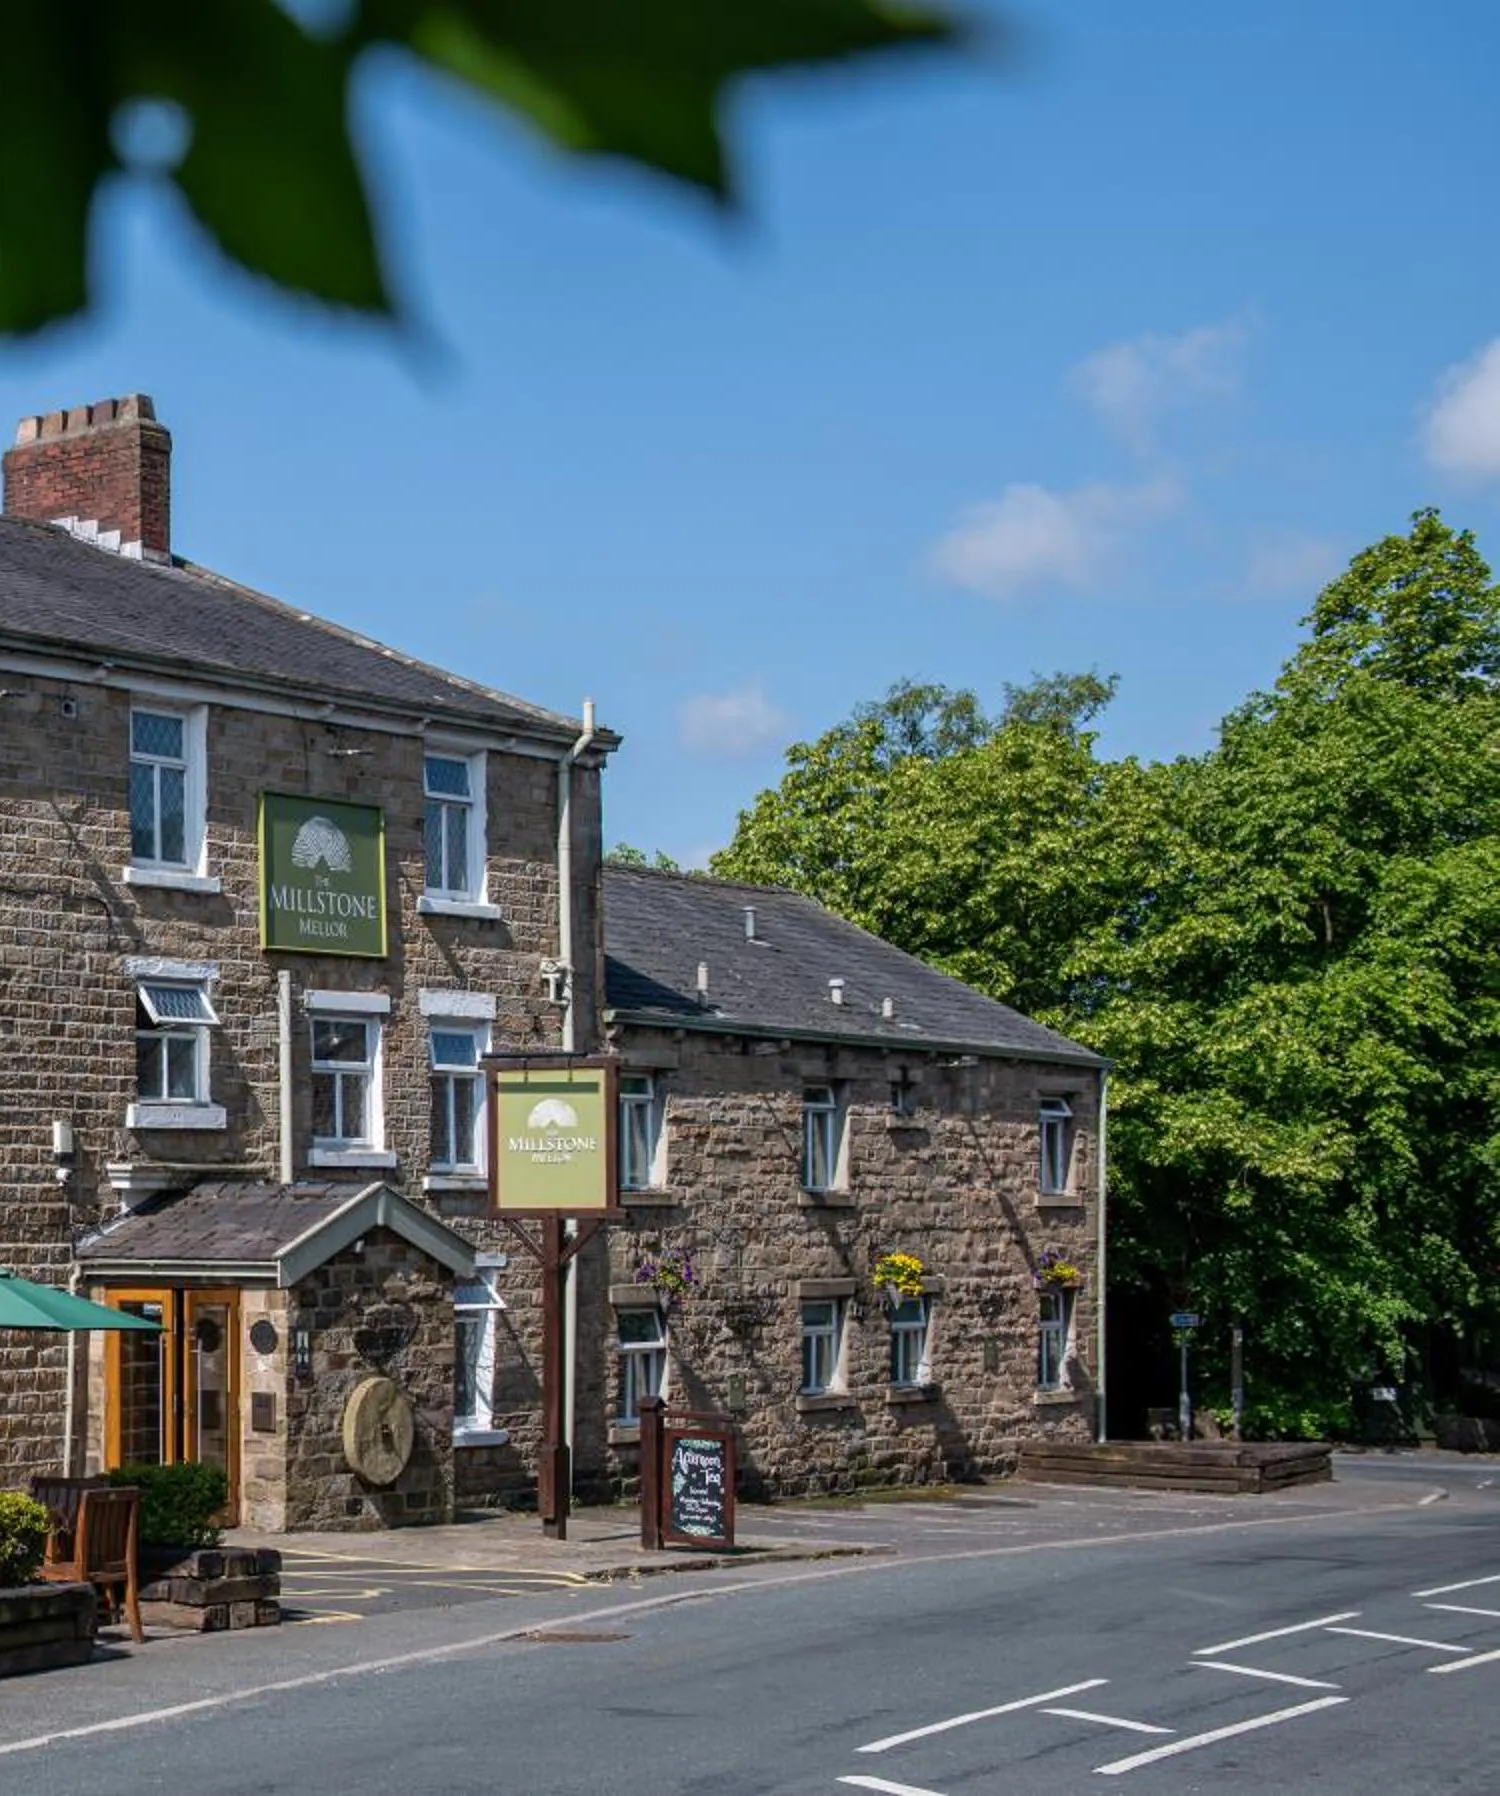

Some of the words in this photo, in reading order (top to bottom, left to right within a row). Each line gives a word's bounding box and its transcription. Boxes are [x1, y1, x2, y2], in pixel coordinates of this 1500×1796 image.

[269, 883, 378, 919] MILLSTONE
[299, 918, 349, 937] MELLOR
[508, 1135, 597, 1152] MILLSTONE
